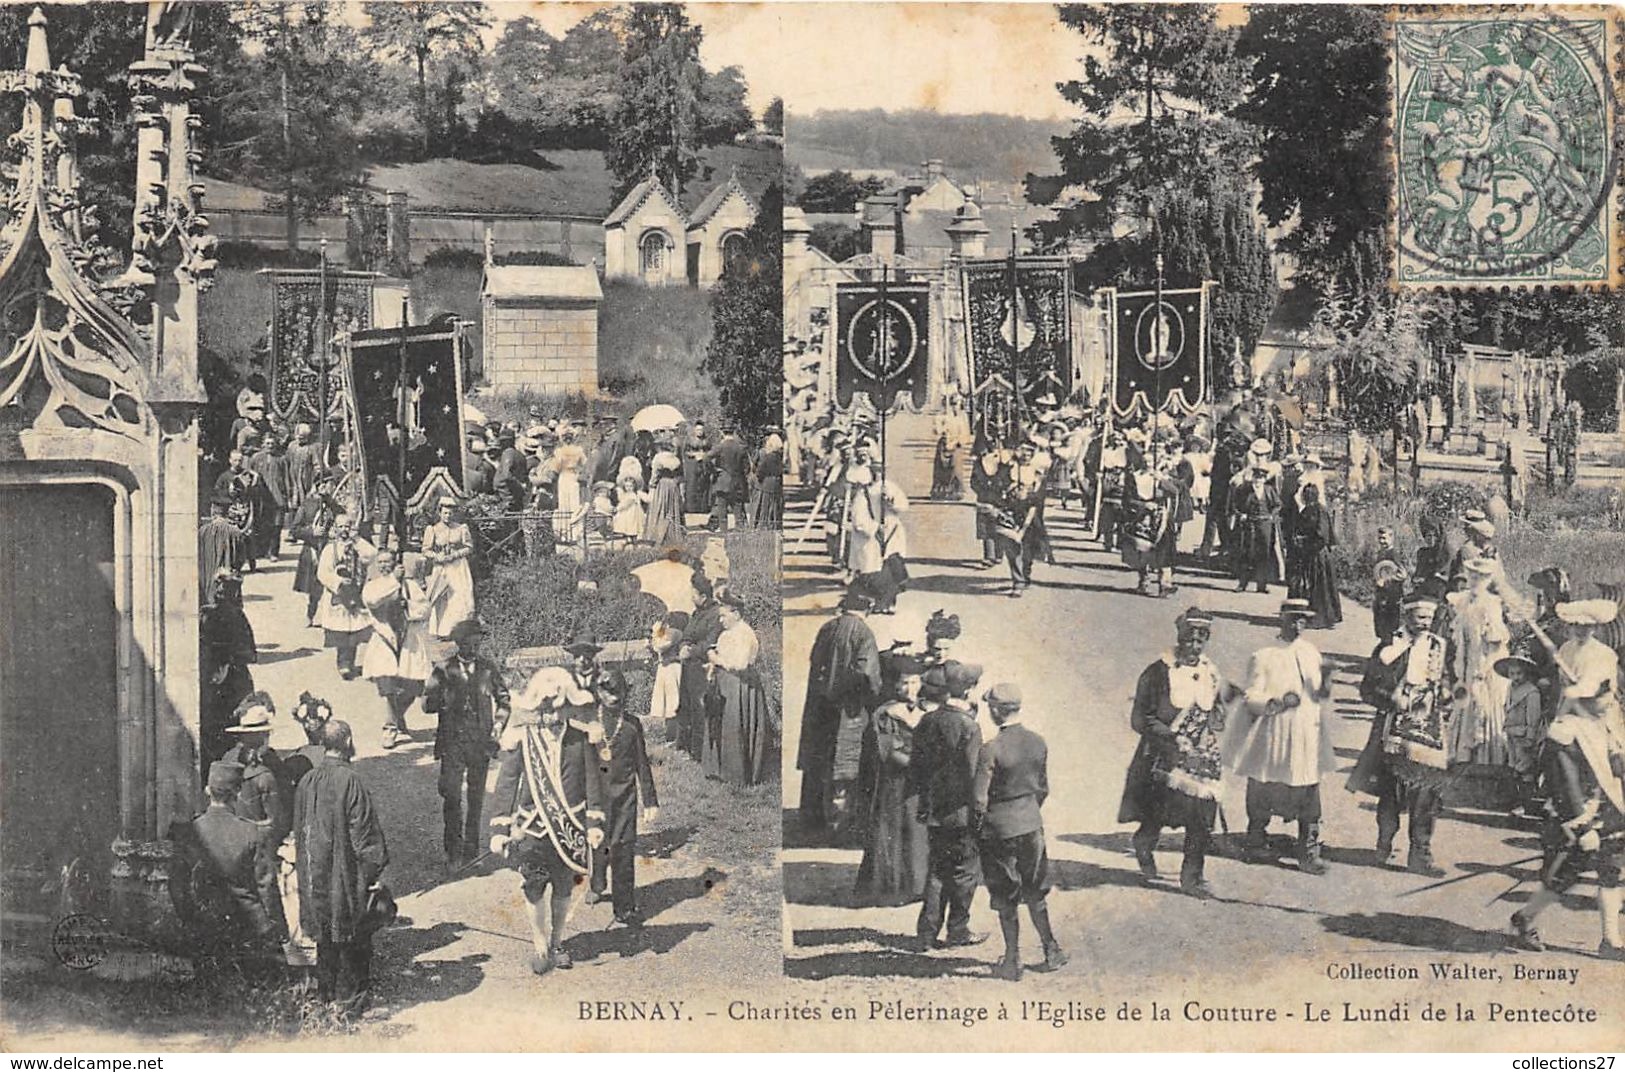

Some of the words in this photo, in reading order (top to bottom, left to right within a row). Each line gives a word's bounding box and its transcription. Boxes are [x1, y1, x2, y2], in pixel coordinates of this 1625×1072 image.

[1487, 174, 1524, 238] 5
[1326, 962, 1419, 980] Collection
[1428, 962, 1503, 984] Walter,
[1513, 963, 1580, 986] Bernay
[577, 1000, 693, 1022] BERNAY.
[727, 999, 822, 1021] Charités
[831, 1007, 858, 1021] en
[997, 1001, 1010, 1021] à
[1116, 1001, 1143, 1022] de
[1151, 1001, 1172, 1022] la
[1183, 1000, 1277, 1022] Couture
[1304, 1002, 1332, 1023] Le
[1342, 1002, 1410, 1022] Lundi
[1420, 1002, 1447, 1022] de
[1456, 1002, 1476, 1022] la
[1487, 1002, 1598, 1023] Pentecôte
